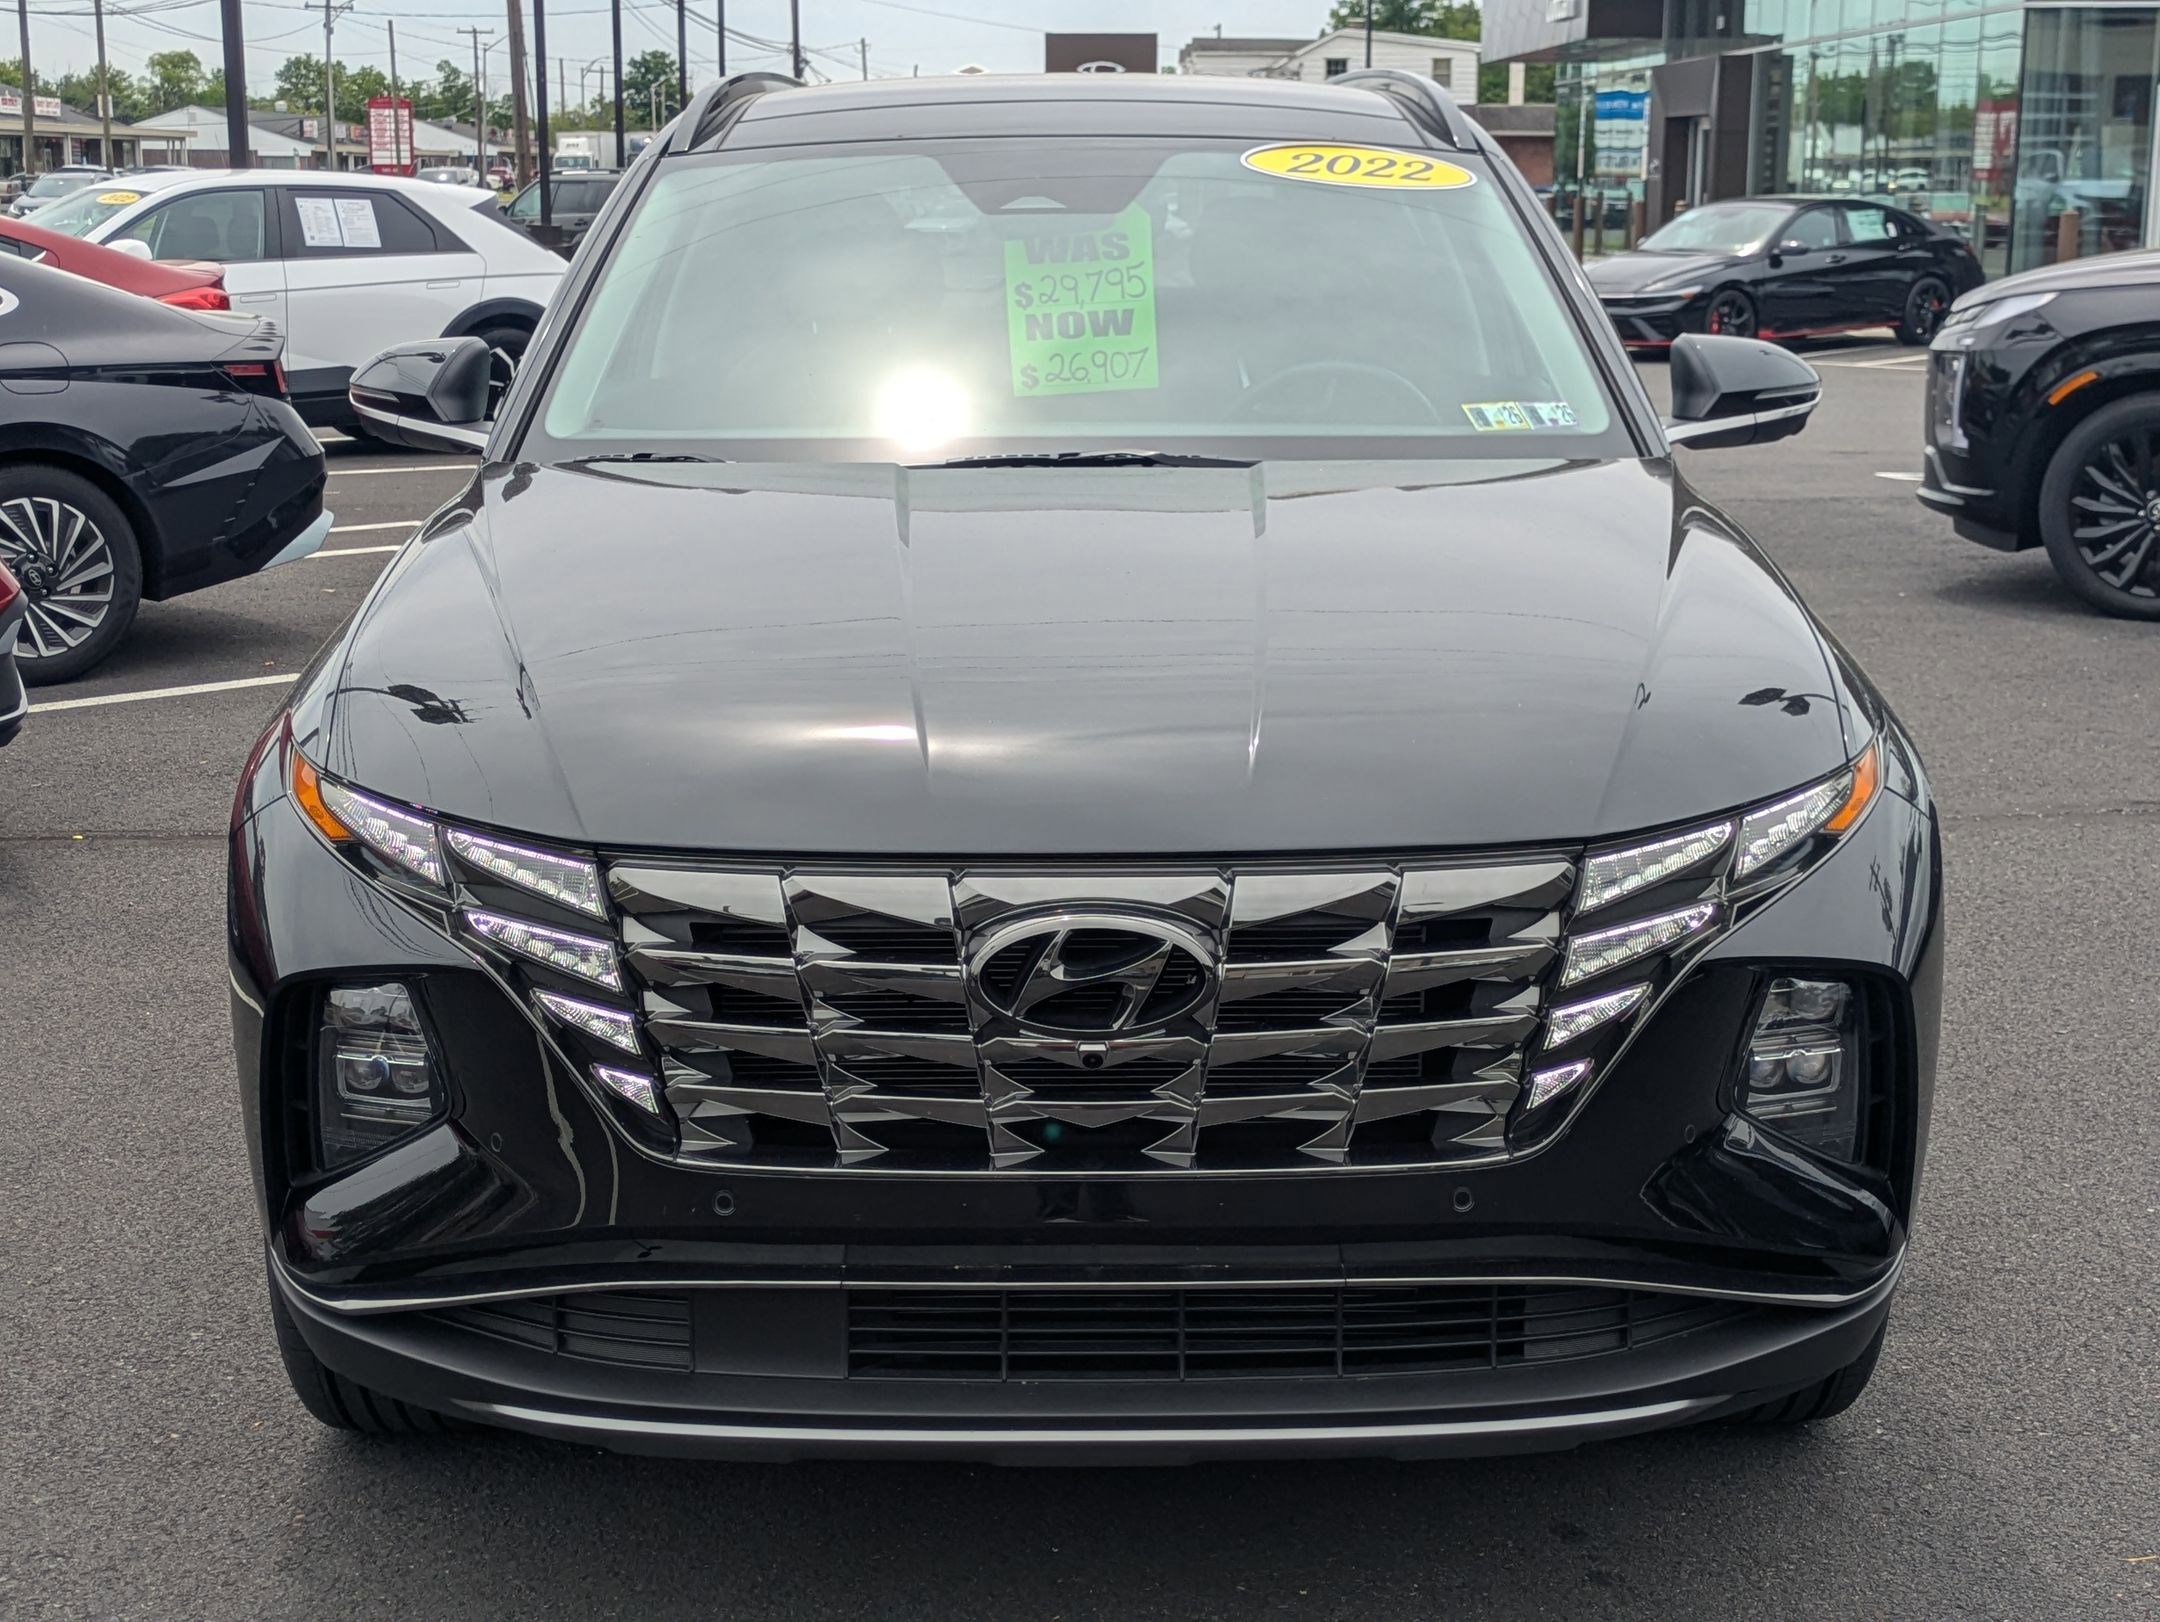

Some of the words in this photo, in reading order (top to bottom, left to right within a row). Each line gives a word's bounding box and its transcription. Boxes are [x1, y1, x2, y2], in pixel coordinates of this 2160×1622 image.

[1286, 152, 1435, 182] 2022
[1024, 231, 1131, 265] WAS
[1014, 261, 1147, 309] $29,795
[1024, 308, 1135, 341] NOW
[1020, 347, 1150, 389] $26,907
